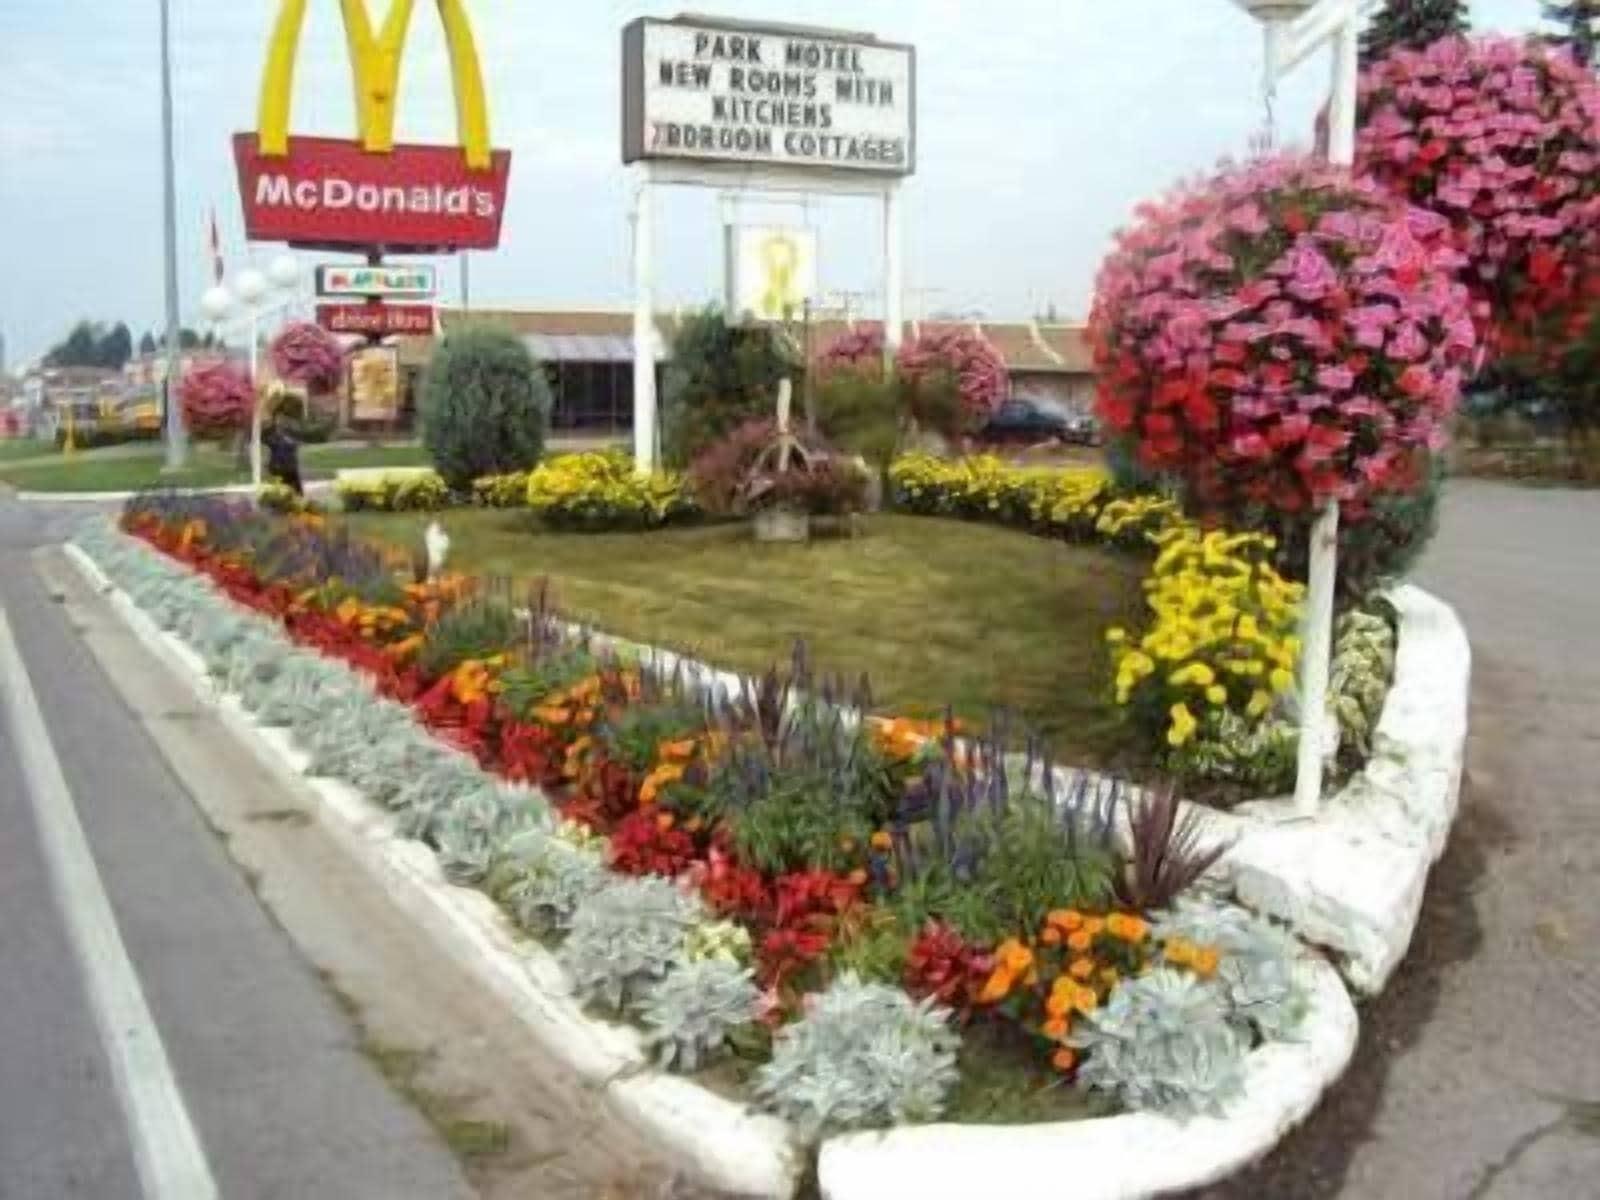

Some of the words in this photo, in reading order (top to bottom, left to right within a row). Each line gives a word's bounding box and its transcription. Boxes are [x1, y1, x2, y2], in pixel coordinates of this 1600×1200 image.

[694, 33, 761, 62] PARK
[785, 42, 863, 73] MOTEL
[659, 62, 712, 89] NEW
[729, 68, 817, 98] ROOMS
[835, 78, 894, 104] WITH
[712, 97, 832, 128] KITCHENS
[255, 174, 496, 217] McDonald's
